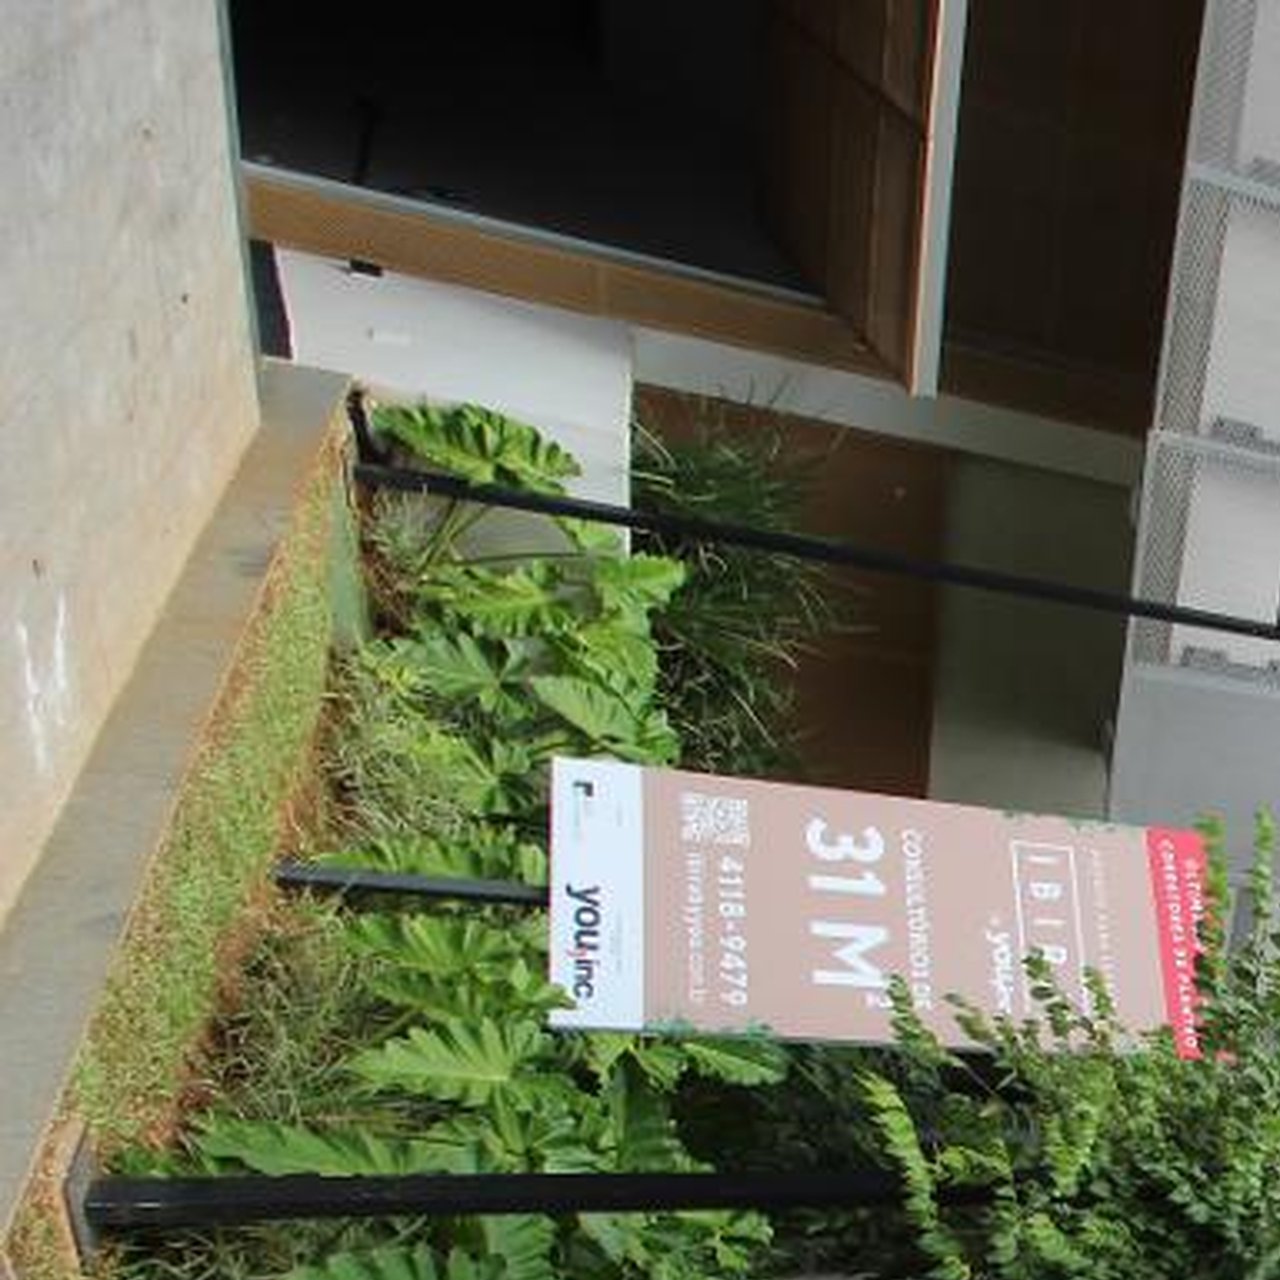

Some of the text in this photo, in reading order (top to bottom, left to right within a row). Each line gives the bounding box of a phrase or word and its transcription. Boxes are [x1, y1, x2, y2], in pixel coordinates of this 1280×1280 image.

[806, 818, 886, 895] 31
[719, 856, 747, 1005] 4118-9479
[1029, 856, 1067, 1006] IBIR
[913, 985, 931, 1010] DE
